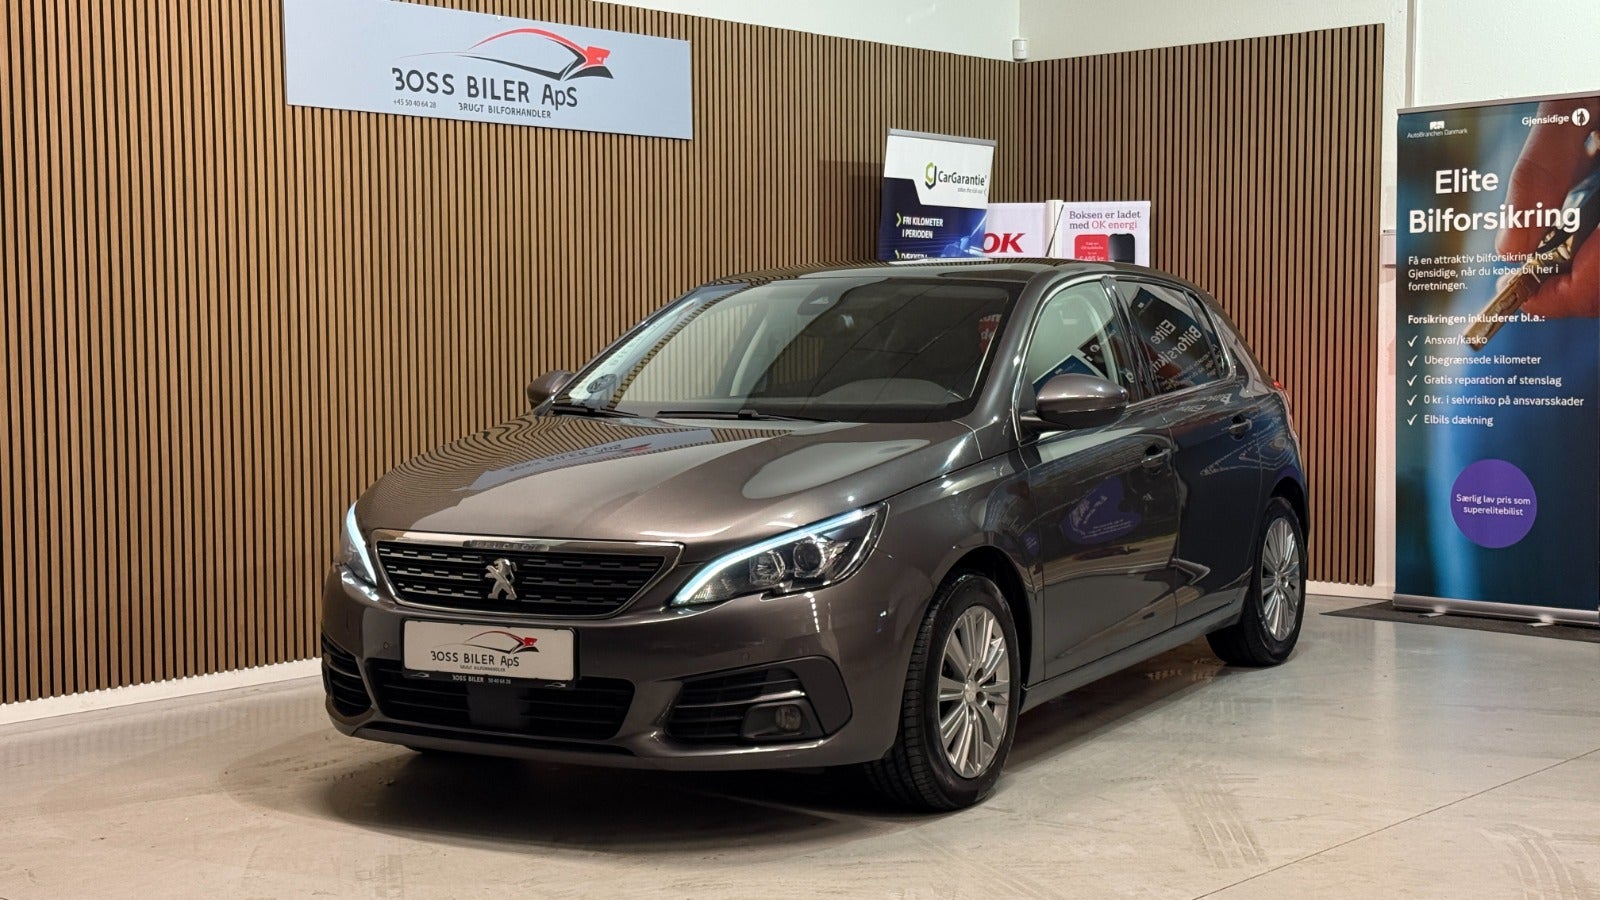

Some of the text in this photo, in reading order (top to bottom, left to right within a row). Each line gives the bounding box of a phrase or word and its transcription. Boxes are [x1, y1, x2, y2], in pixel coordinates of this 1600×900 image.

[467, 75, 531, 104] BILER
[541, 84, 578, 111] ApS
[405, 99, 412, 107] 50
[488, 104, 552, 119] BILFORHANDLER
[1522, 114, 1569, 126] Gjensidige
[1444, 128, 1467, 137] Danmark
[1435, 168, 1499, 195] Elite
[1069, 210, 1103, 220] Boksen
[1117, 210, 1142, 220] ladet
[1409, 202, 1581, 233] Bilforsikring
[902, 216, 944, 227] FRI KILOMETER
[1069, 220, 1138, 231] med OK energi
[905, 230, 933, 239] PERIODEN
[983, 232, 1024, 254] OK
[1408, 251, 1554, 265] Få en attraktiv bilforsikring hos
[1408, 267, 1458, 279] Gjensidige,
[1461, 266, 1476, 276] når
[1478, 266, 1490, 276] du
[1492, 265, 1521, 276] køber
[1522, 264, 1534, 275] bil
[1536, 264, 1552, 274] her
[1408, 280, 1468, 292] forretningen.
[1408, 313, 1545, 325] Forsikringen inkluderer bl.a.:
[1424, 334, 1488, 346] Ansvar/kasko
[1424, 354, 1542, 366] Ubegrænsede kilometer
[1424, 374, 1562, 387] Gratis reparation af stenslag
[1424, 395, 1430, 405] 0
[1432, 395, 1444, 405] kr.
[1451, 395, 1496, 406] selvrisiko
[1498, 394, 1511, 410] på
[1512, 396, 1584, 407] ansvarsskader
[1424, 414, 1494, 427] Elbils dækning
[1456, 494, 1531, 506] Særlig lav pris som
[1464, 506, 1524, 517] superelitebilist
[464, 653, 495, 666] BILER
[500, 656, 520, 669] ApS
